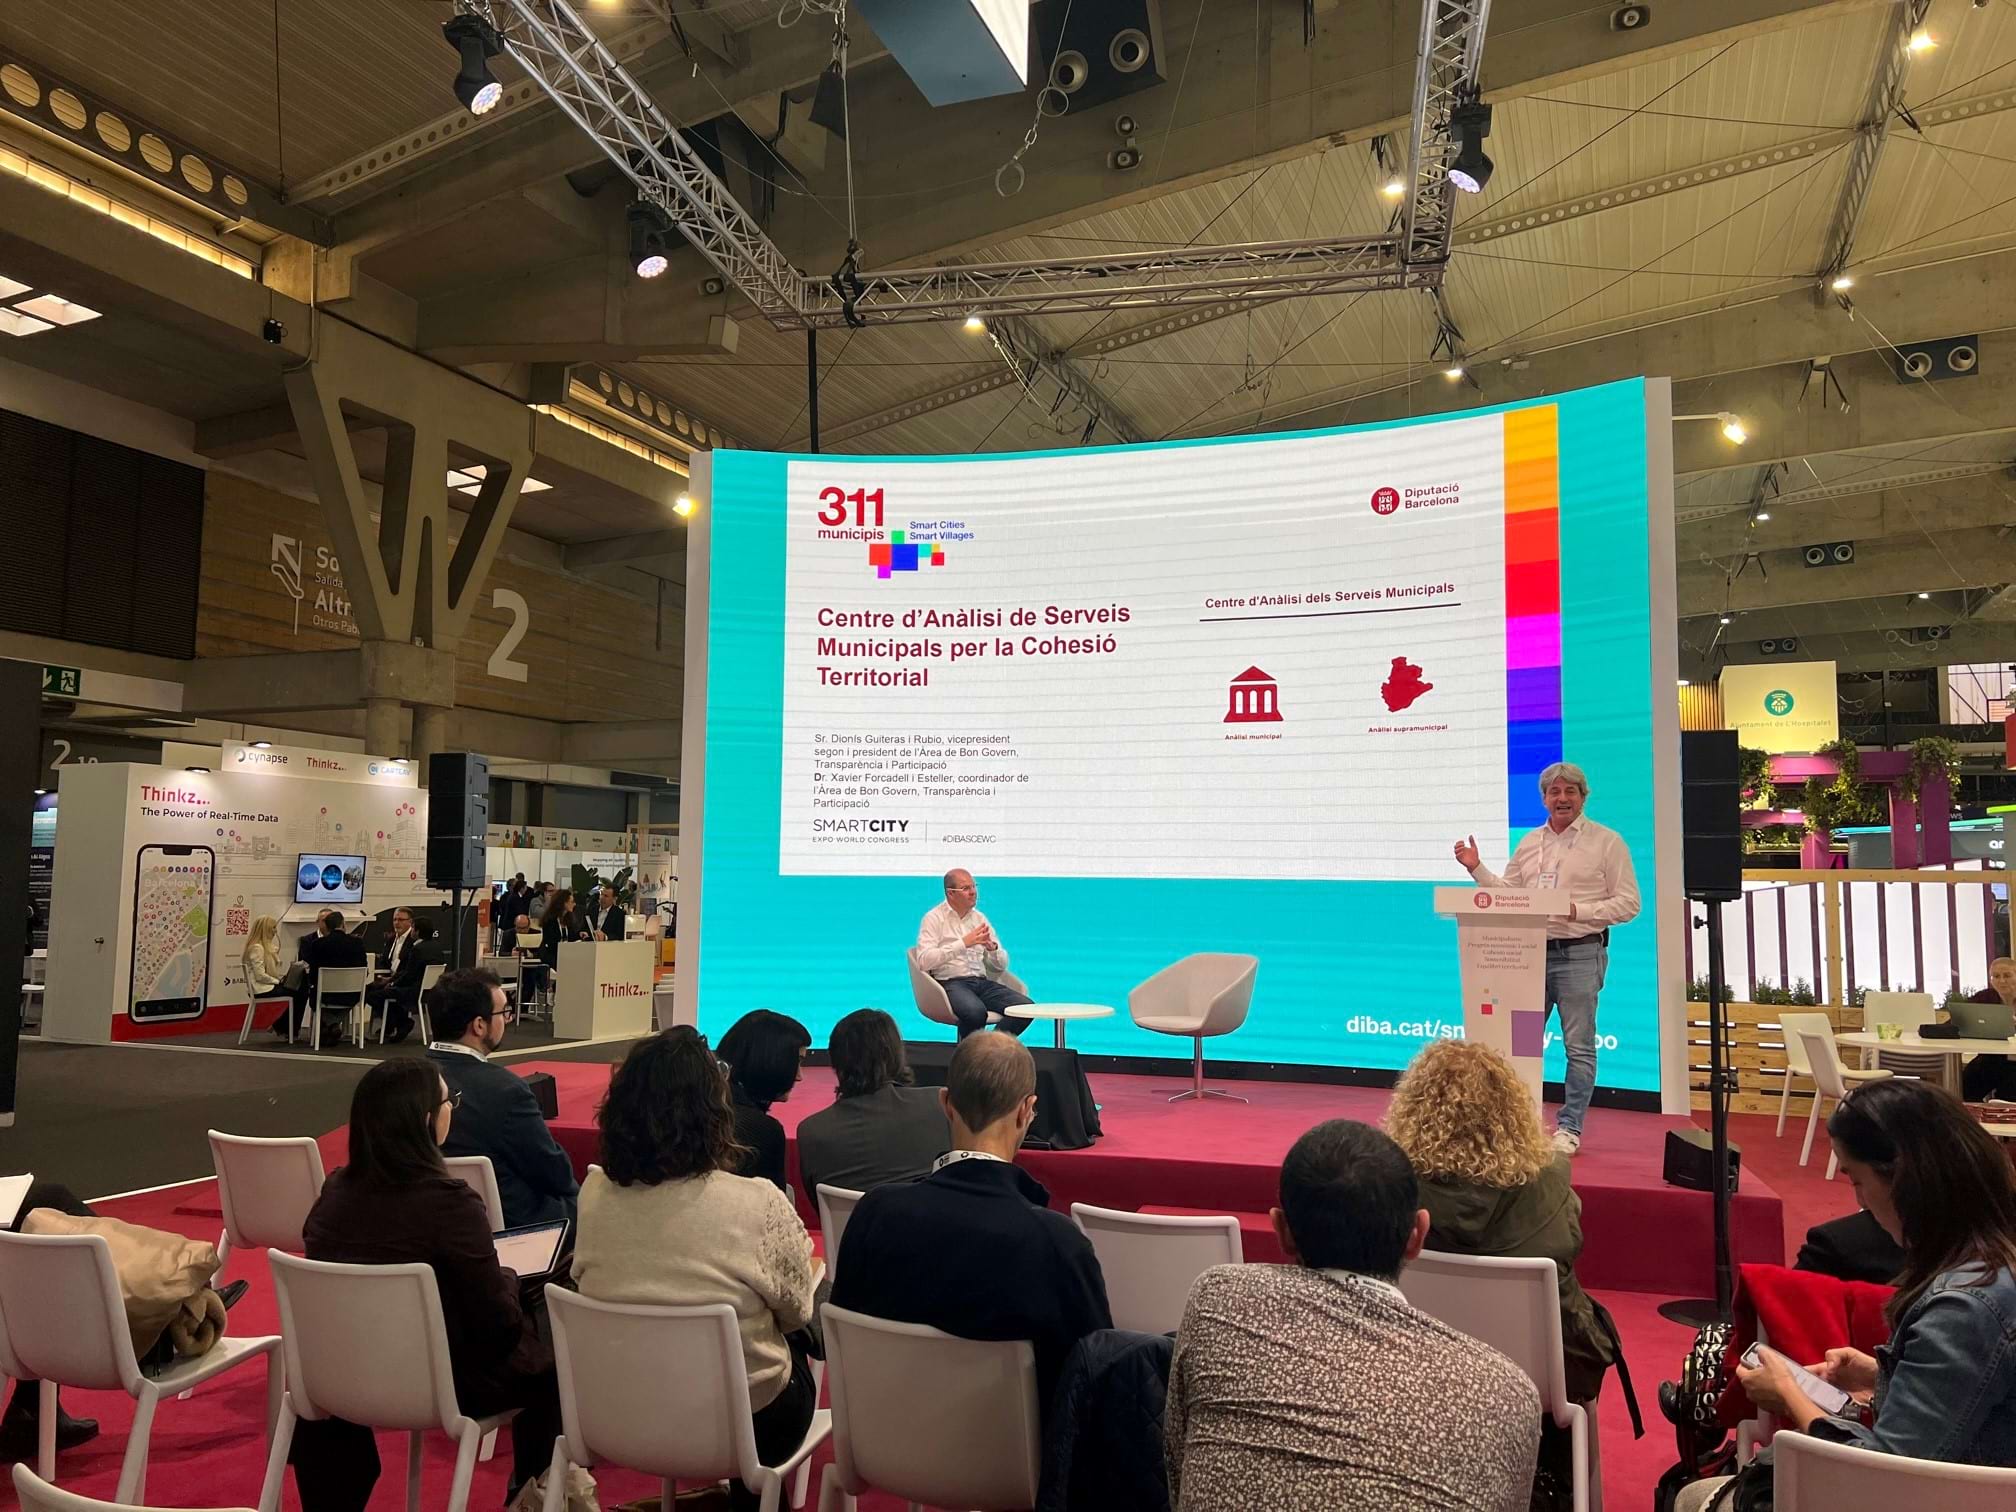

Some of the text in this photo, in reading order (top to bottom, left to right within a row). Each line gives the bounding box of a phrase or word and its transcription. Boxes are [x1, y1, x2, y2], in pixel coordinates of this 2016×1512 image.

[1405, 483, 1459, 498] Diputació
[818, 487, 884, 526] 311
[1405, 496, 1459, 509] Barcelona
[910, 521, 965, 529] Smart Cities
[818, 528, 884, 542] municipis
[910, 531, 974, 541] Smart Villages
[315, 572, 344, 588] Salida
[1205, 583, 1454, 609] Centre d'Anàlisi dels Serveis Municipals
[314, 589, 353, 617] Altr
[313, 614, 339, 630] Otros
[817, 604, 1130, 627] Centre d’Anàlisi de Serveis
[487, 588, 529, 683] 2
[817, 634, 1116, 661] Municipals per la Cohesió
[817, 667, 928, 686] Territorial
[1394, 724, 1448, 734] supramunicipal
[815, 734, 828, 743] Sr.
[865, 734, 905, 744] Guiteras
[914, 735, 944, 745] Rubio,
[948, 734, 1011, 745] vicepresident
[1249, 733, 1282, 741] municipal
[814, 748, 844, 758] segon
[852, 747, 897, 758] president
[900, 748, 912, 757] de
[914, 746, 941, 757] l'Àrea
[945, 748, 957, 757] de
[960, 748, 978, 757] Bon
[981, 748, 1019, 758] Govern,
[814, 759, 883, 771] Transparència
[891, 760, 947, 771] Participació
[814, 773, 828, 782] Dr.
[831, 773, 862, 782] Xavier
[865, 773, 909, 782] Forcadell
[917, 773, 955, 783] Esteller,
[958, 773, 1014, 782] coordinador
[1017, 773, 1029, 782] de
[813, 784, 842, 795] l'Àrea
[844, 787, 857, 795] de
[860, 787, 879, 795] Bon
[882, 787, 920, 796] Govern,
[923, 787, 991, 797] Transparència
[813, 799, 870, 810] Participació
[141, 807, 279, 823] The Power of Real-Time Data
[813, 819, 909, 832] SMARTCITY
[1495, 894, 1529, 902] Diputació
